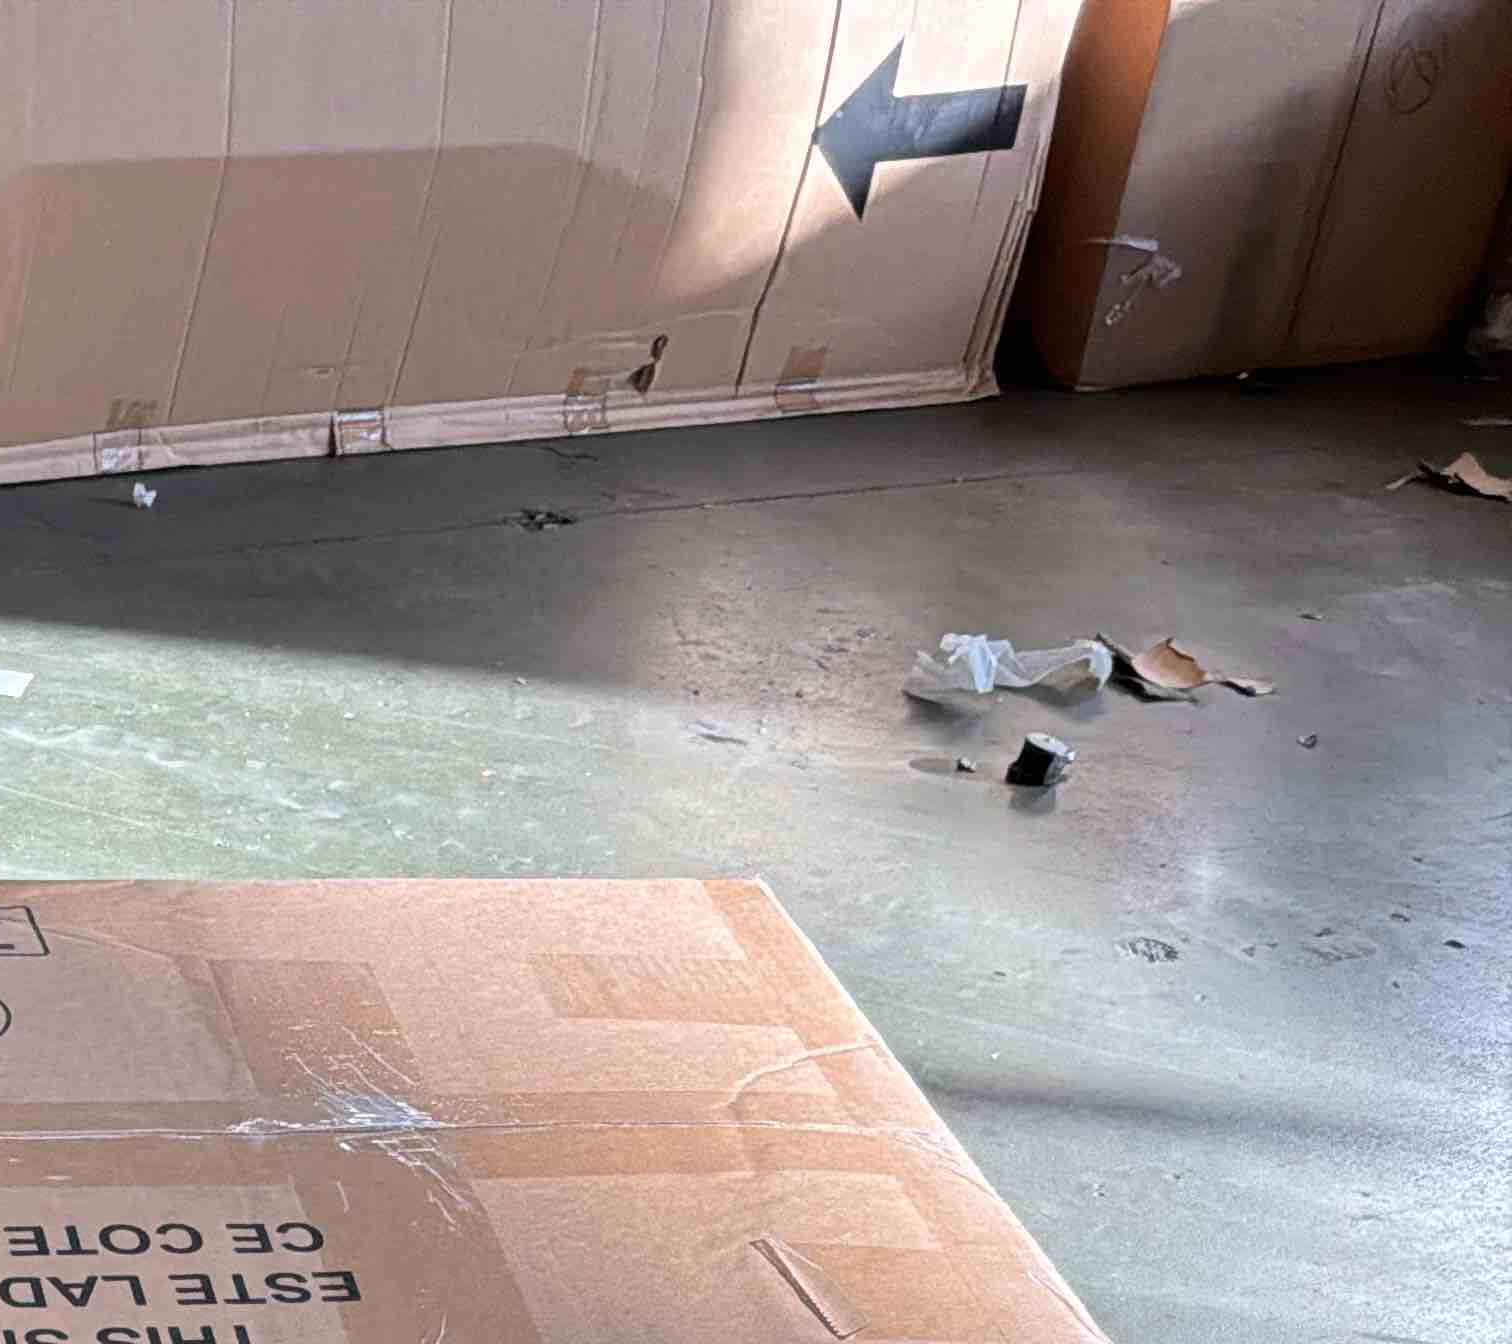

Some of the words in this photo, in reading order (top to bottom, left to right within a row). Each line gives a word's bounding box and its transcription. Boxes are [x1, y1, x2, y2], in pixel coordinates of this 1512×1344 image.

[5, 1224, 203, 1256] COTE
[226, 1223, 324, 1253] CE
[168, 1271, 361, 1305] ESTE
